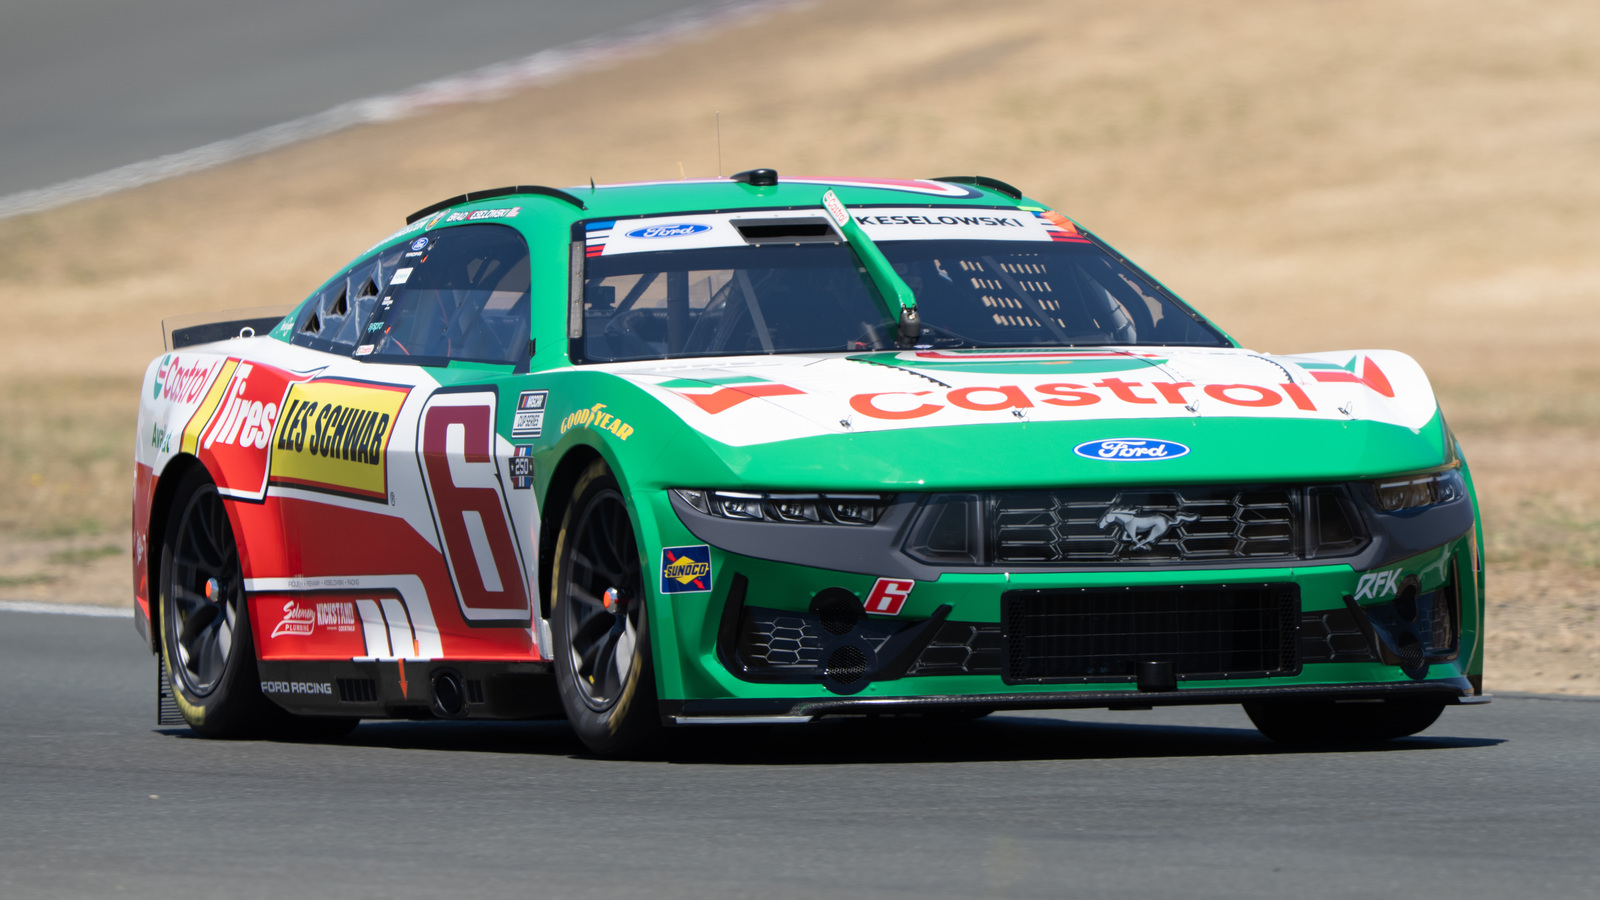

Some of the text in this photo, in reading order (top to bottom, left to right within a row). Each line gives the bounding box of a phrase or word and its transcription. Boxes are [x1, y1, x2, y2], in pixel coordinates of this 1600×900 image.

[446, 212, 468, 223] BRAD
[828, 198, 847, 223] Castrol
[856, 215, 1024, 228] KESELOWSKI
[164, 356, 218, 404] Castrol
[203, 363, 277, 450] Tires
[849, 377, 1317, 420] Castrol
[278, 399, 389, 465] LES SCHWAB
[1097, 439, 1168, 458] Ford
[515, 458, 529, 475] 250
[423, 405, 528, 611] 6
[666, 563, 707, 577] SUNOCO
[1354, 567, 1403, 600] RFK
[866, 578, 914, 614] 6
[316, 602, 355, 626] KICKSTAND
[285, 624, 309, 632] PLUMBING
[261, 681, 332, 694] FORD RACING
